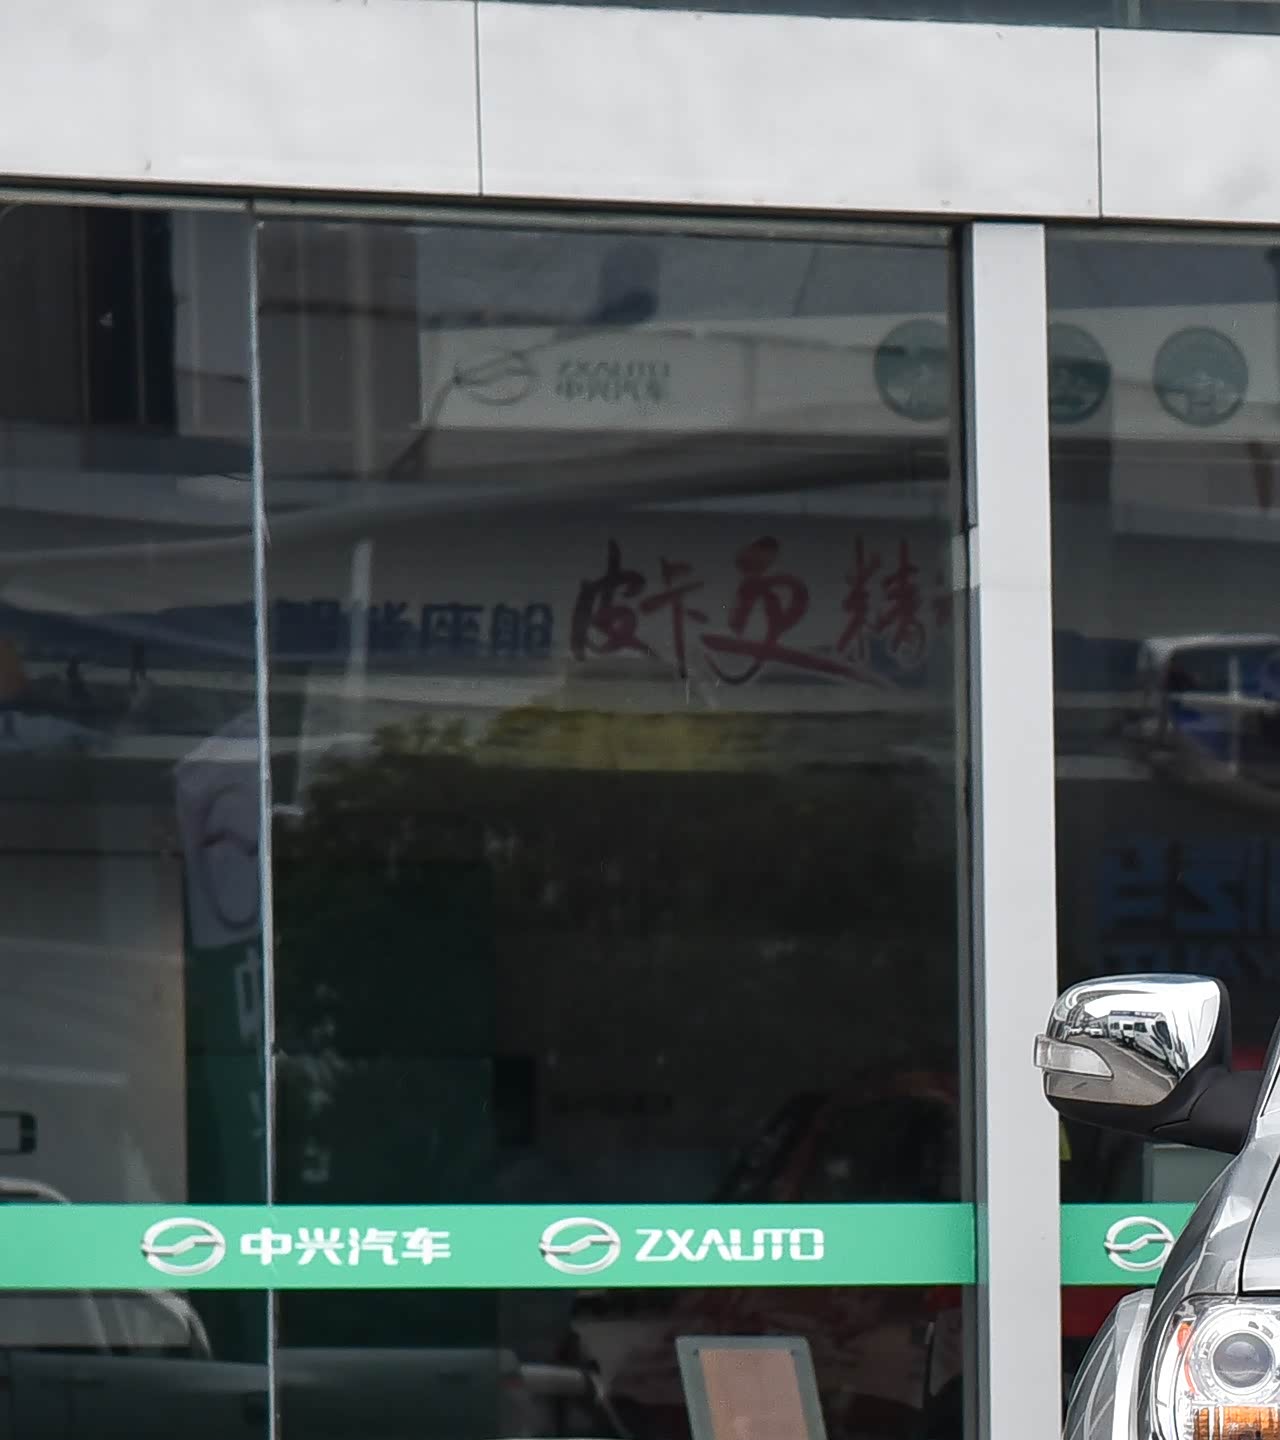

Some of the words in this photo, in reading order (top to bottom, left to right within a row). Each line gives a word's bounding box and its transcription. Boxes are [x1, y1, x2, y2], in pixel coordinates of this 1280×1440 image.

[240, 1227, 451, 1266] 中兴汽车
[635, 1228, 825, 1262] ZXAUTO
